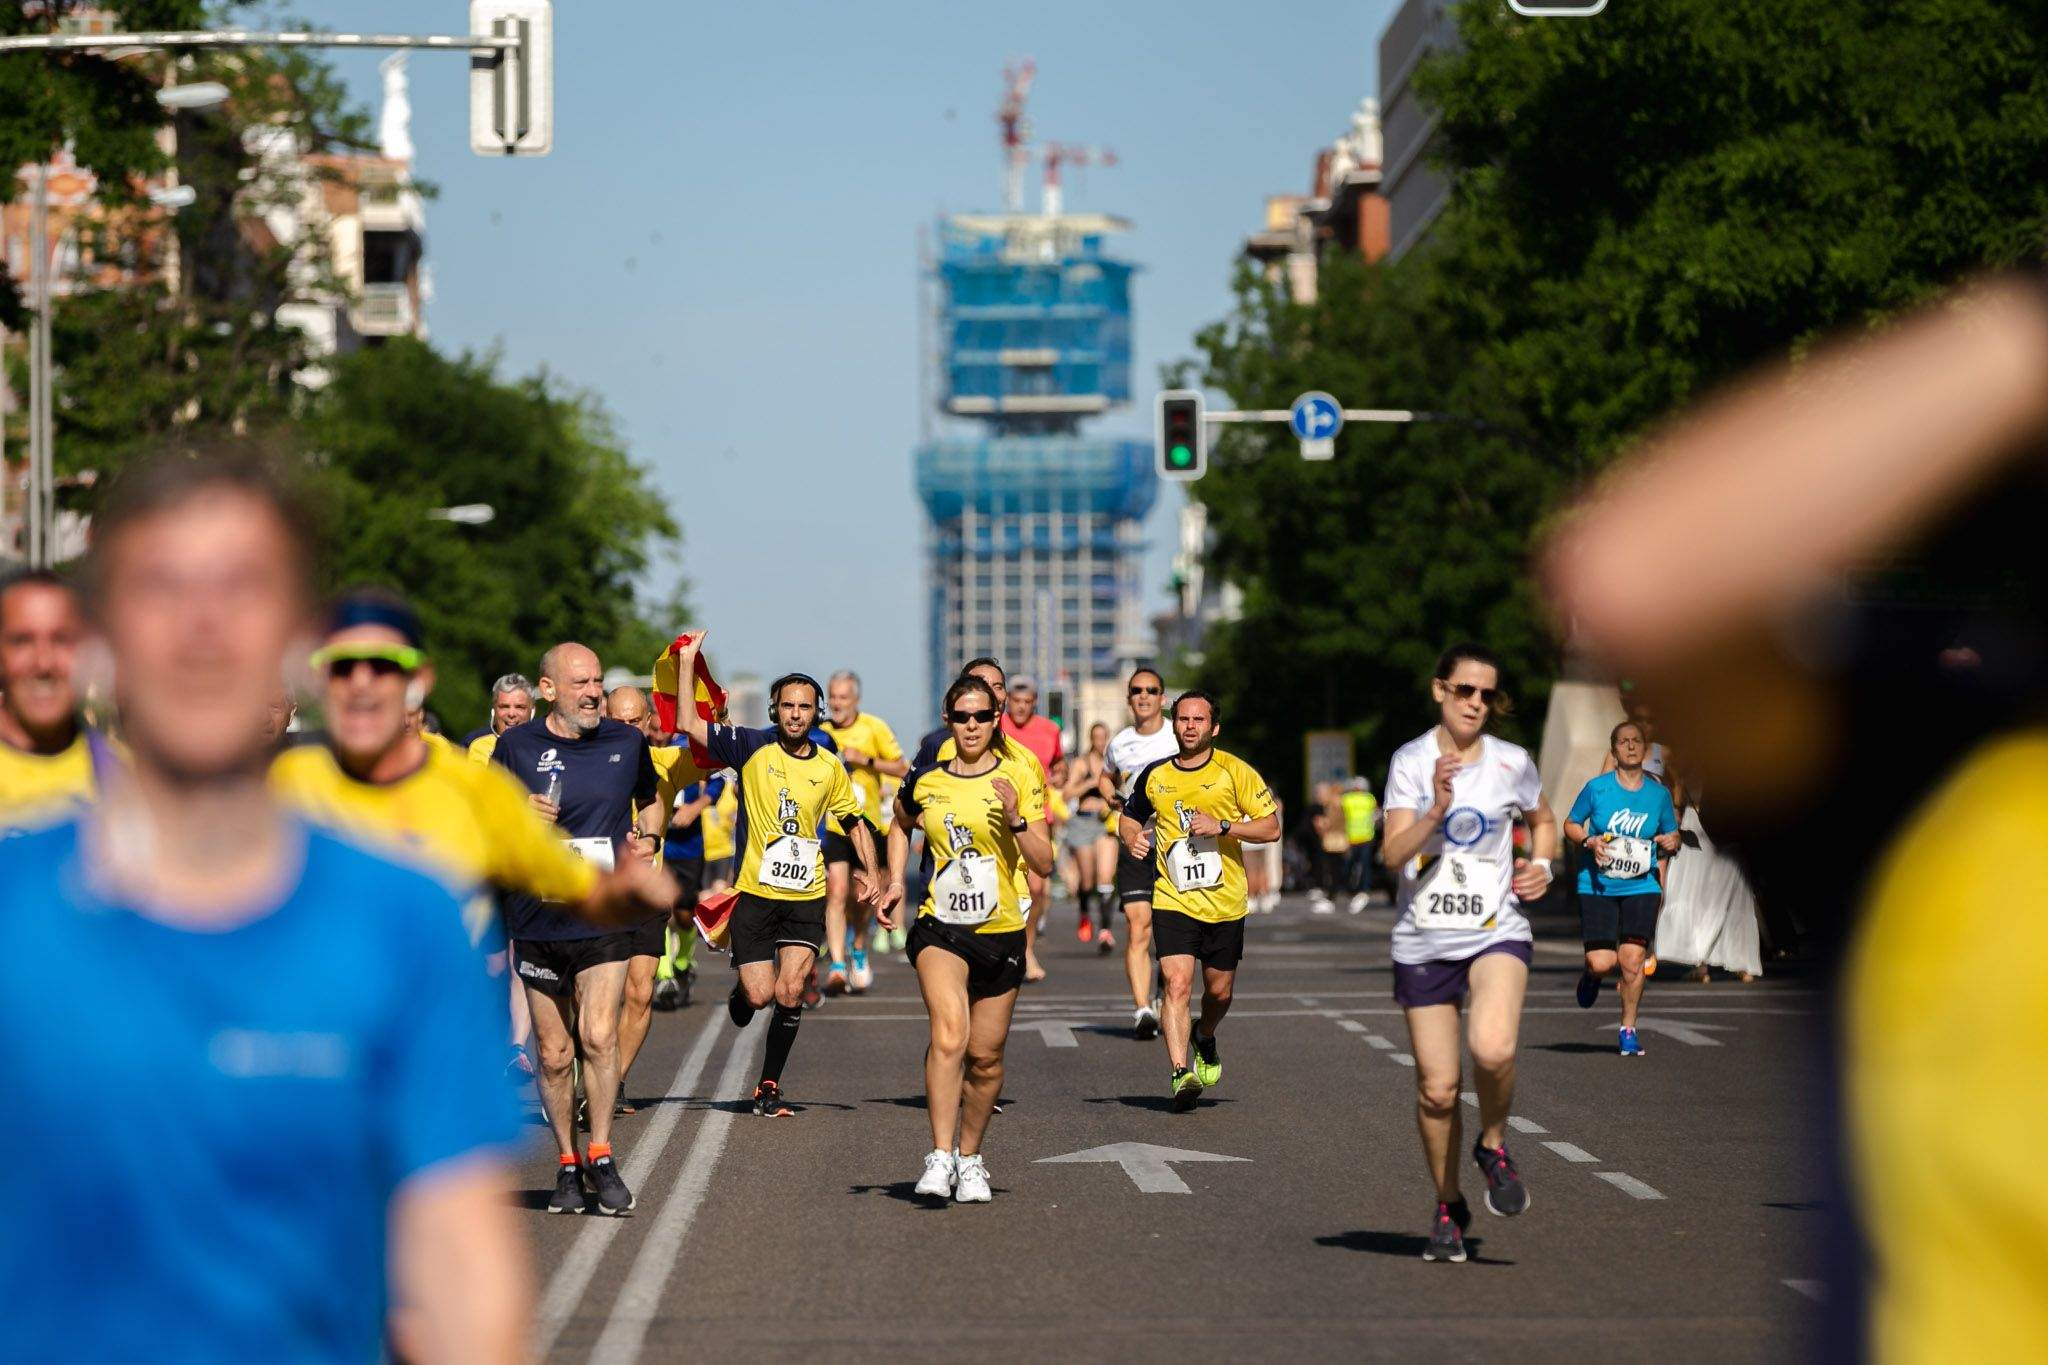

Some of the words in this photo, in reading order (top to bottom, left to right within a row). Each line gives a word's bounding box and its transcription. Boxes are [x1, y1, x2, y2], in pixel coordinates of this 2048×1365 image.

[786, 822, 797, 833] 13
[772, 861, 807, 881] 3202
[1183, 862, 1205, 881] 717
[949, 892, 985, 912] 2811
[1429, 893, 1484, 916] 2636
